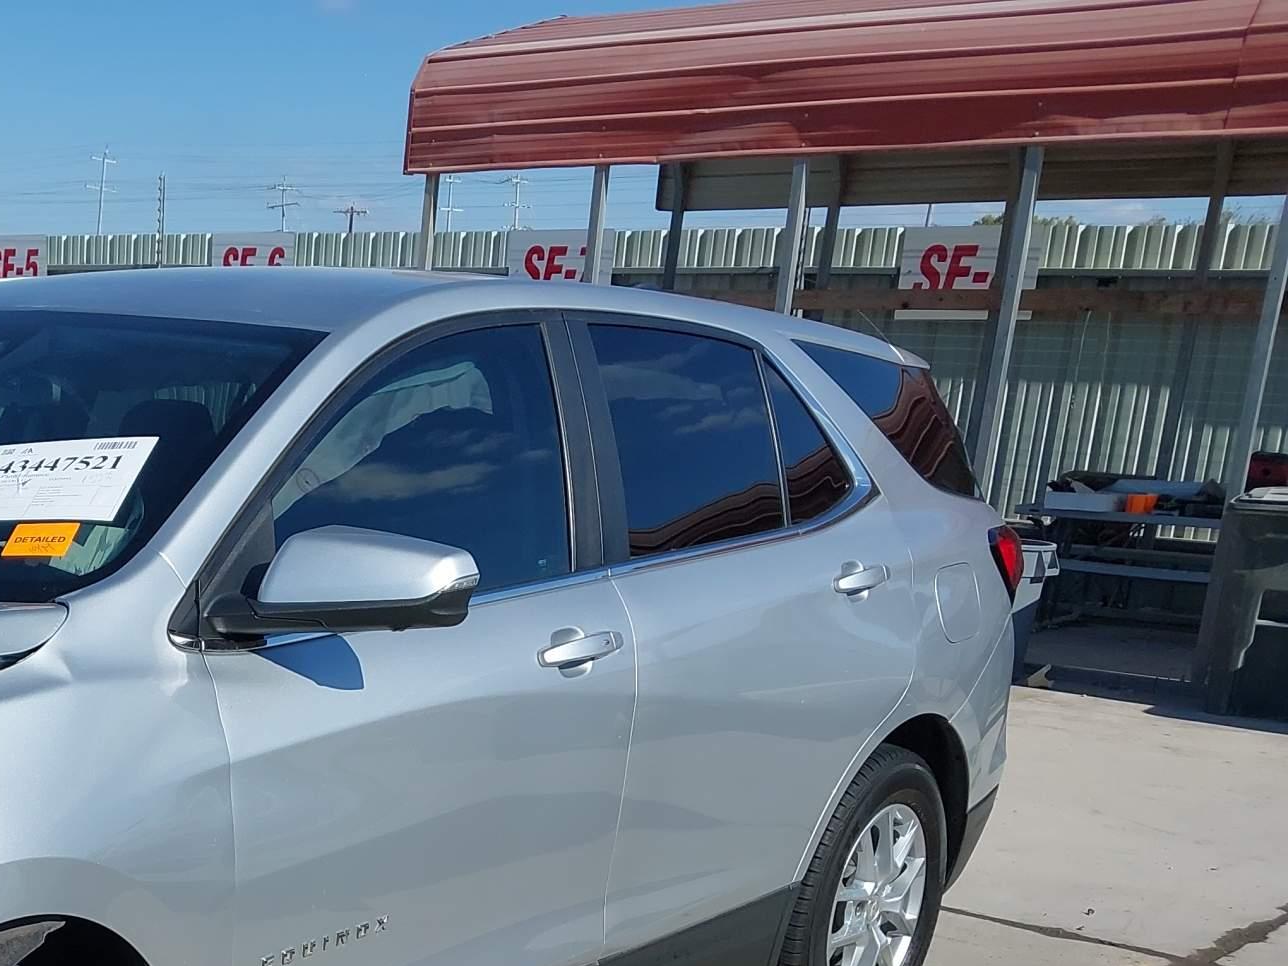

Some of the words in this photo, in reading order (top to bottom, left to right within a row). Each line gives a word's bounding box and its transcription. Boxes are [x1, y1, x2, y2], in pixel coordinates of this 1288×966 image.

[524, 245, 587, 282] SF-
[912, 244, 990, 290] SF-
[14, 535, 66, 544] DETAILED
